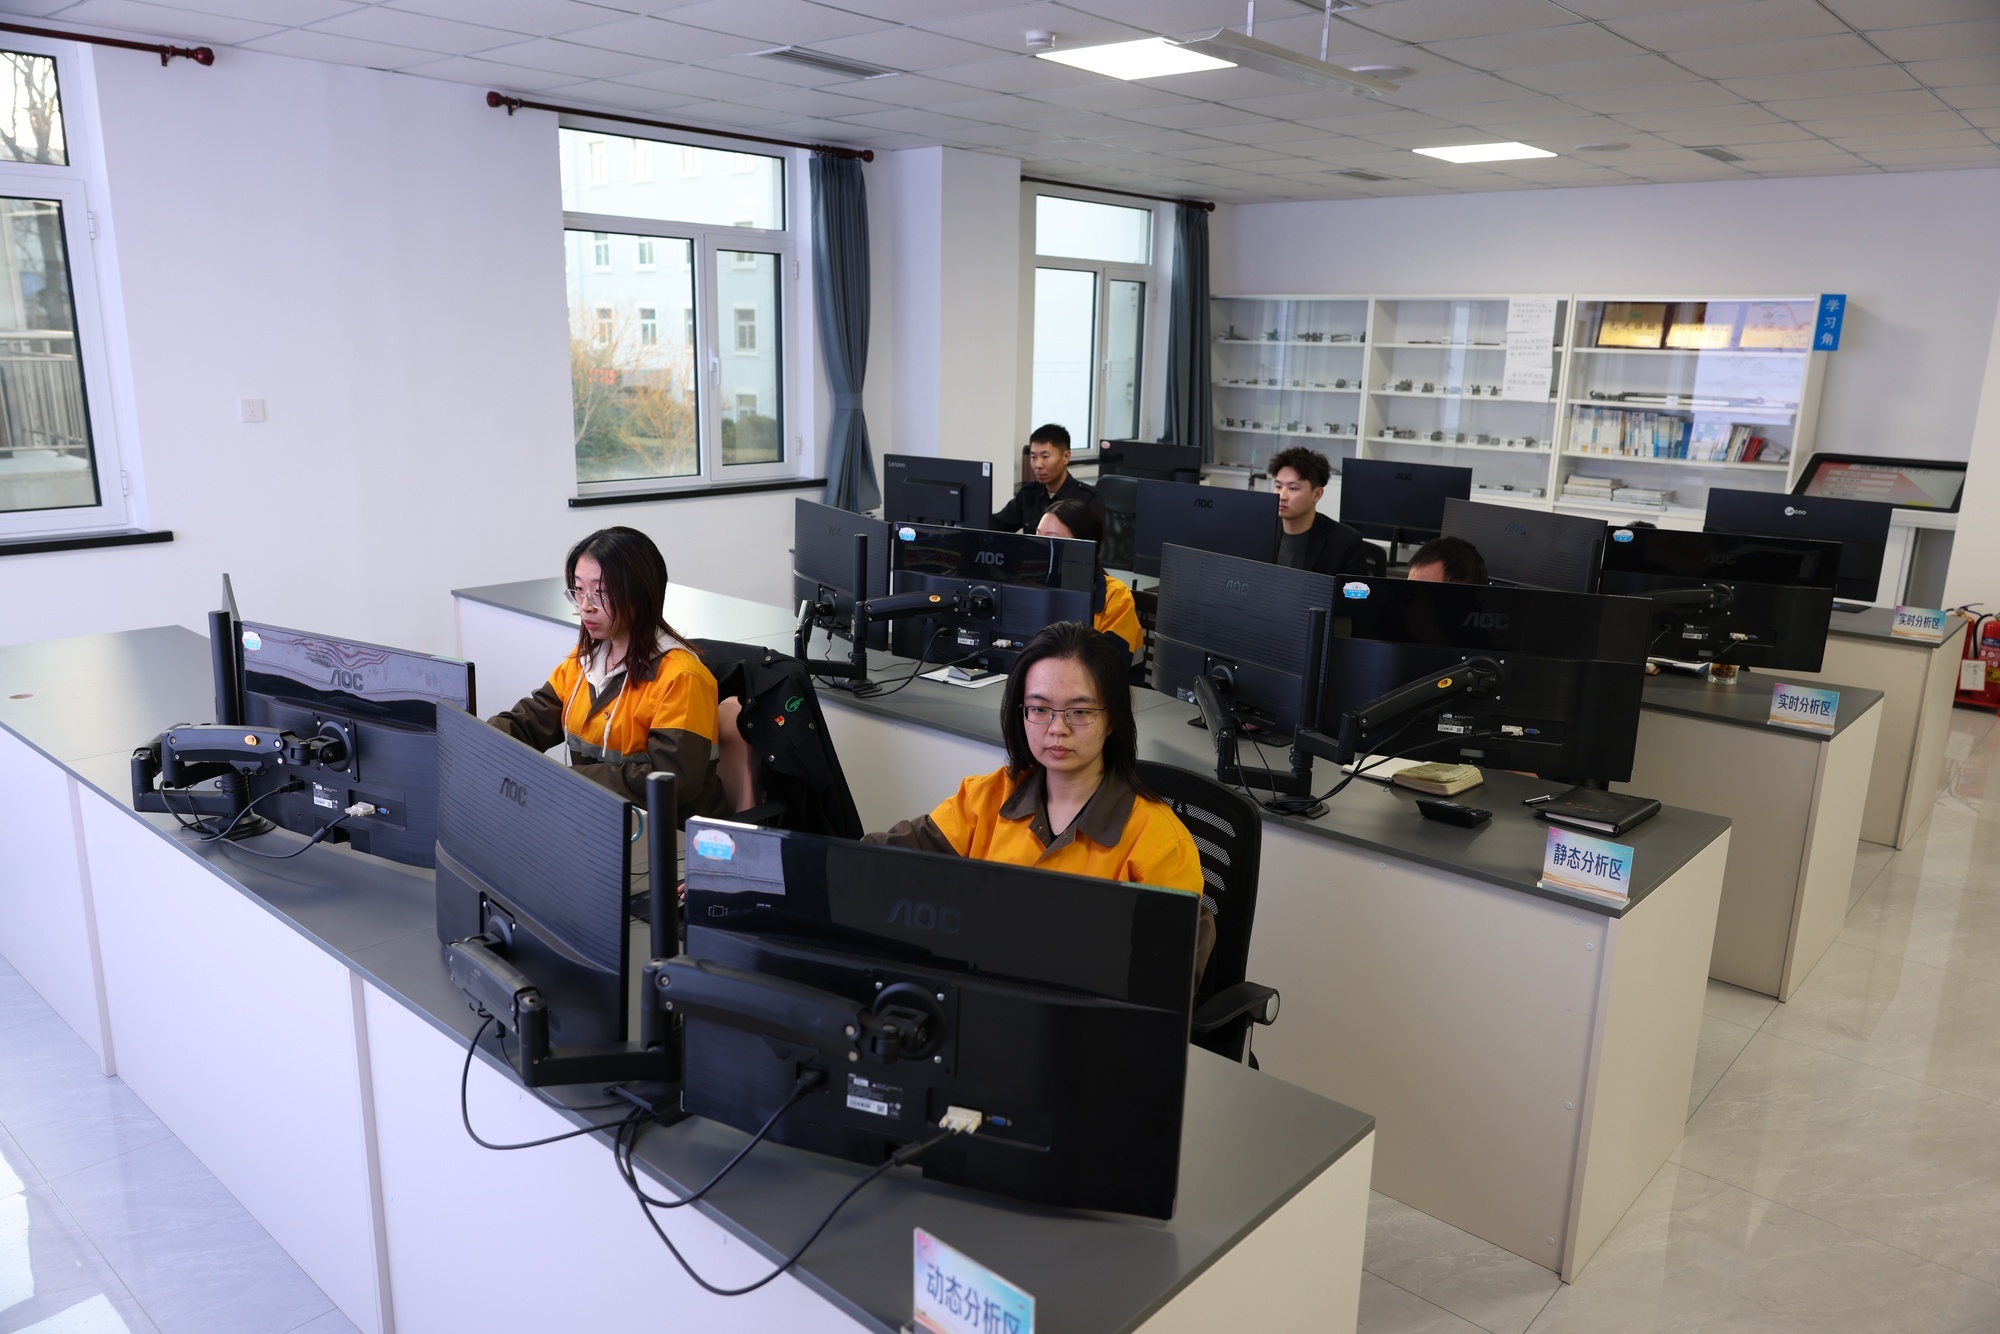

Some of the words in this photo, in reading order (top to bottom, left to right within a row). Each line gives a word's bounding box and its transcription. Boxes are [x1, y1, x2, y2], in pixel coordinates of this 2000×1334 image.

[1820, 299, 1840, 346] 学习角
[888, 460, 906, 469] Lenovo
[1193, 498, 1214, 508] AOC
[974, 551, 1005, 566] AOC
[1703, 552, 1738, 565] AOC
[1223, 579, 1249, 596] AOC
[1462, 611, 1510, 630] AOC
[1898, 613, 1940, 630] 实时分析区
[330, 669, 364, 691] AOC
[1778, 694, 1832, 717] 实时分析区
[499, 777, 528, 807] AOC
[1553, 842, 1624, 881] 静态分析区
[886, 898, 960, 935] AOC
[926, 1262, 1021, 1334] 动态分析区
